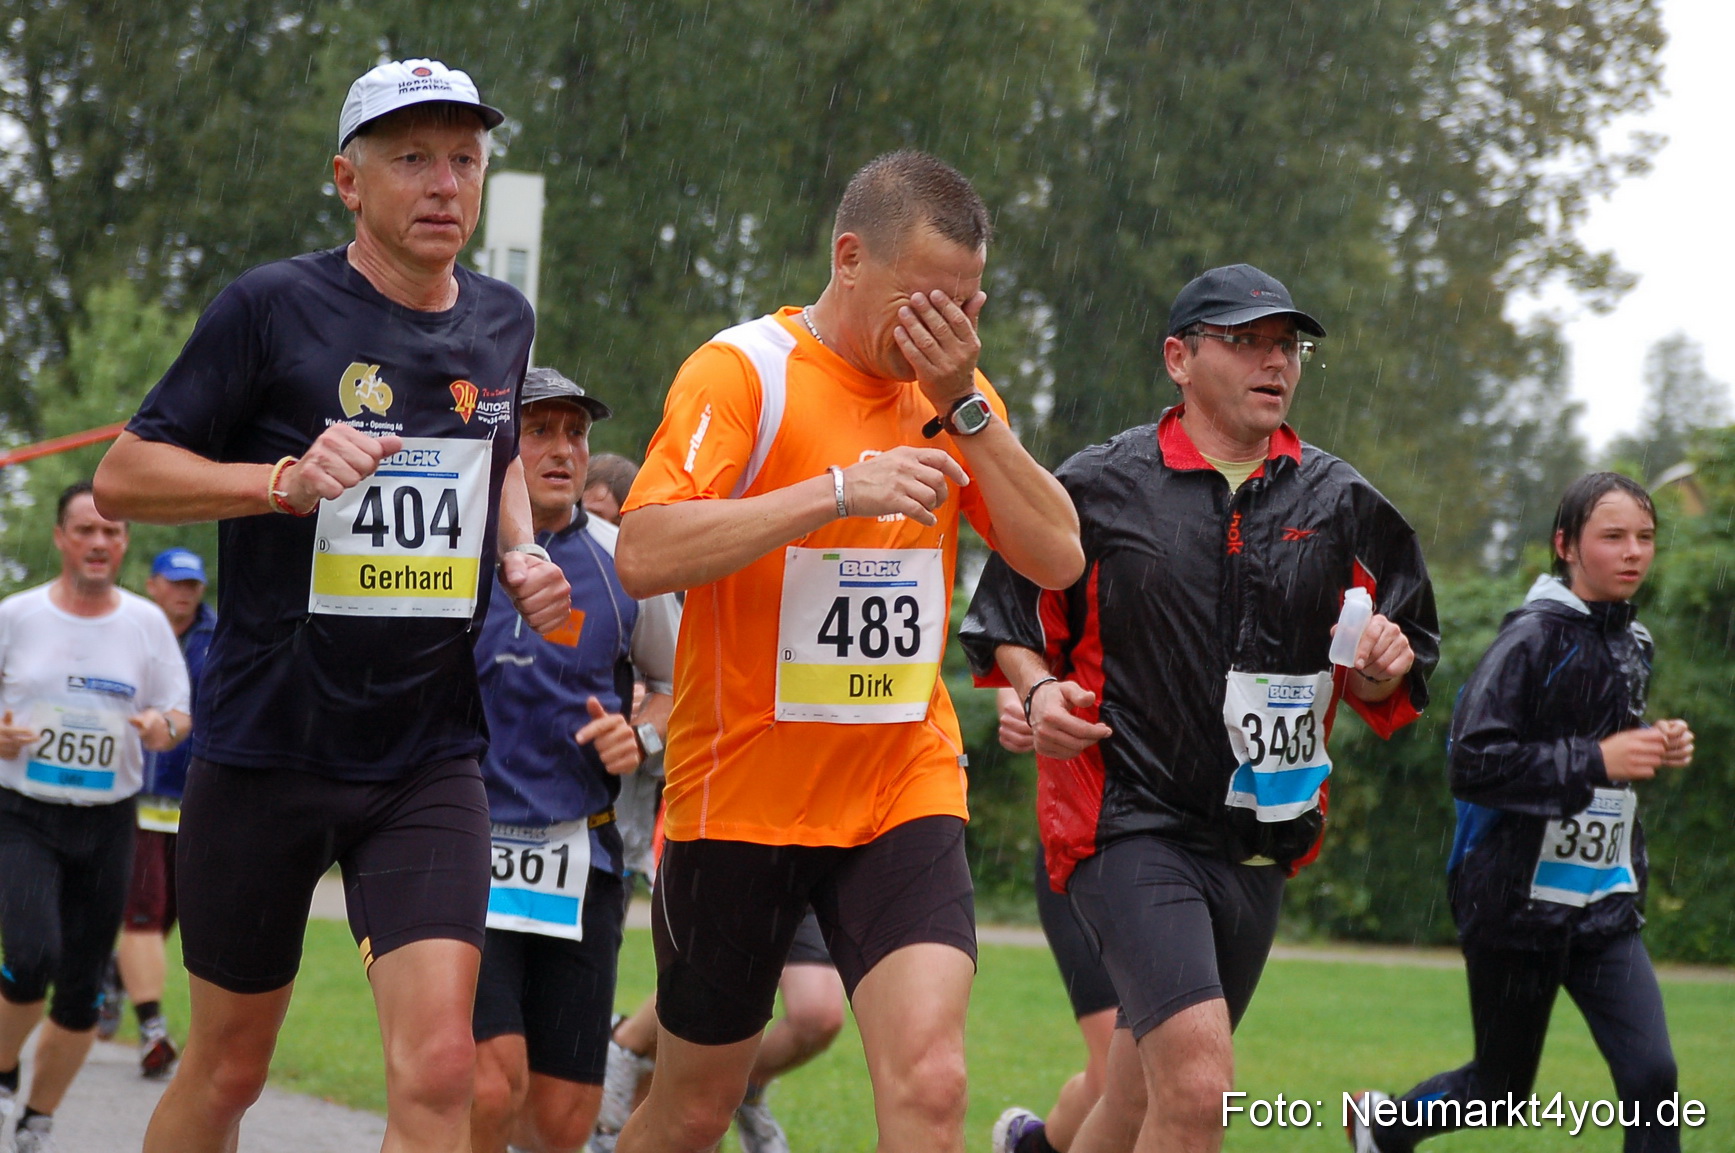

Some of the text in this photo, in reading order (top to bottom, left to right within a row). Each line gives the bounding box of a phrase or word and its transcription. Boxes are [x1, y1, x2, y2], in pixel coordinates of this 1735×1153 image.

[352, 485, 462, 550] 404
[360, 563, 453, 591] Gerhard
[839, 560, 901, 577] BOCK
[817, 595, 921, 659] 483
[849, 674, 894, 698] Dirk
[1268, 684, 1315, 699] BOCK
[36, 728, 116, 767] 2650
